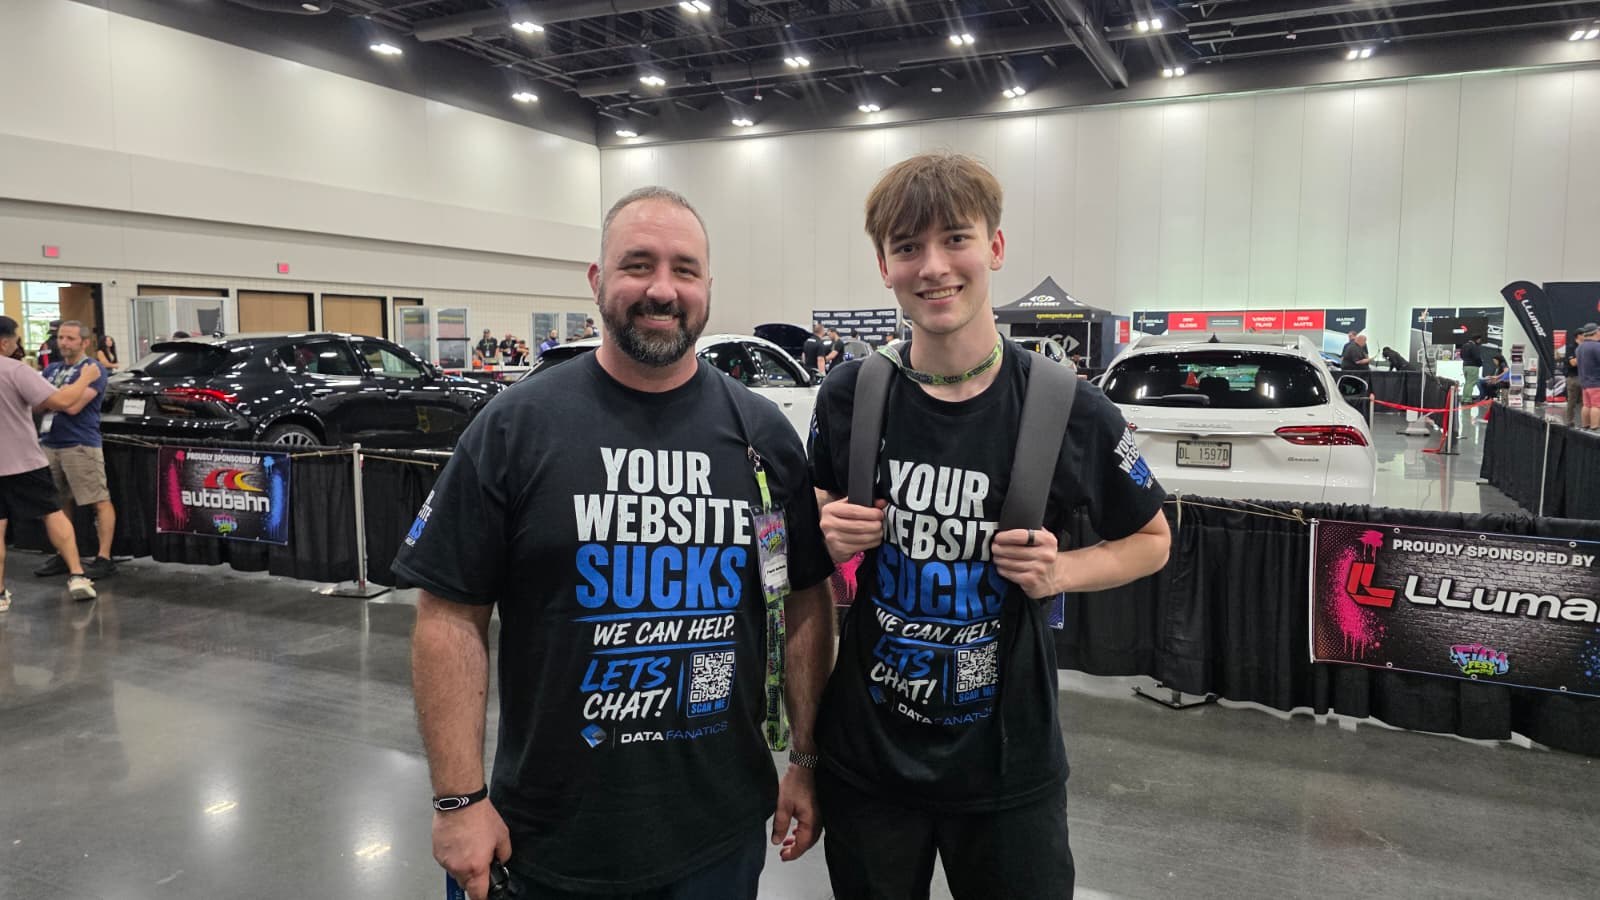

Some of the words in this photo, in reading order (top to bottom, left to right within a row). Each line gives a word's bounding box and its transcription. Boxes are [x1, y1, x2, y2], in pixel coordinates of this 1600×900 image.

[186, 452, 213, 461] PROUDLY
[213, 453, 251, 464] SPONSORED
[251, 456, 261, 465] BY
[600, 447, 712, 495] YOUR
[1179, 447, 1191, 460] DL
[181, 488, 270, 512] autobahn
[888, 459, 990, 518] YOUR
[573, 494, 750, 544] WEBSITE
[883, 502, 1000, 561] EBSIT
[1392, 538, 1464, 557] PROUDLY
[1468, 545, 1568, 566] SPONSORED
[1571, 554, 1595, 568] BY
[576, 543, 747, 609] SUCKS
[1404, 574, 1600, 624] LLuma
[593, 622, 631, 646] WE
[635, 619, 683, 644] CAN
[687, 615, 735, 641] HELP.
[902, 623, 950, 642] CAN
[579, 655, 671, 693] LETS
[871, 661, 937, 704] CHAT!
[583, 688, 672, 721] CHAT!
[691, 702, 712, 714] SCAN
[715, 698, 727, 710] ME
